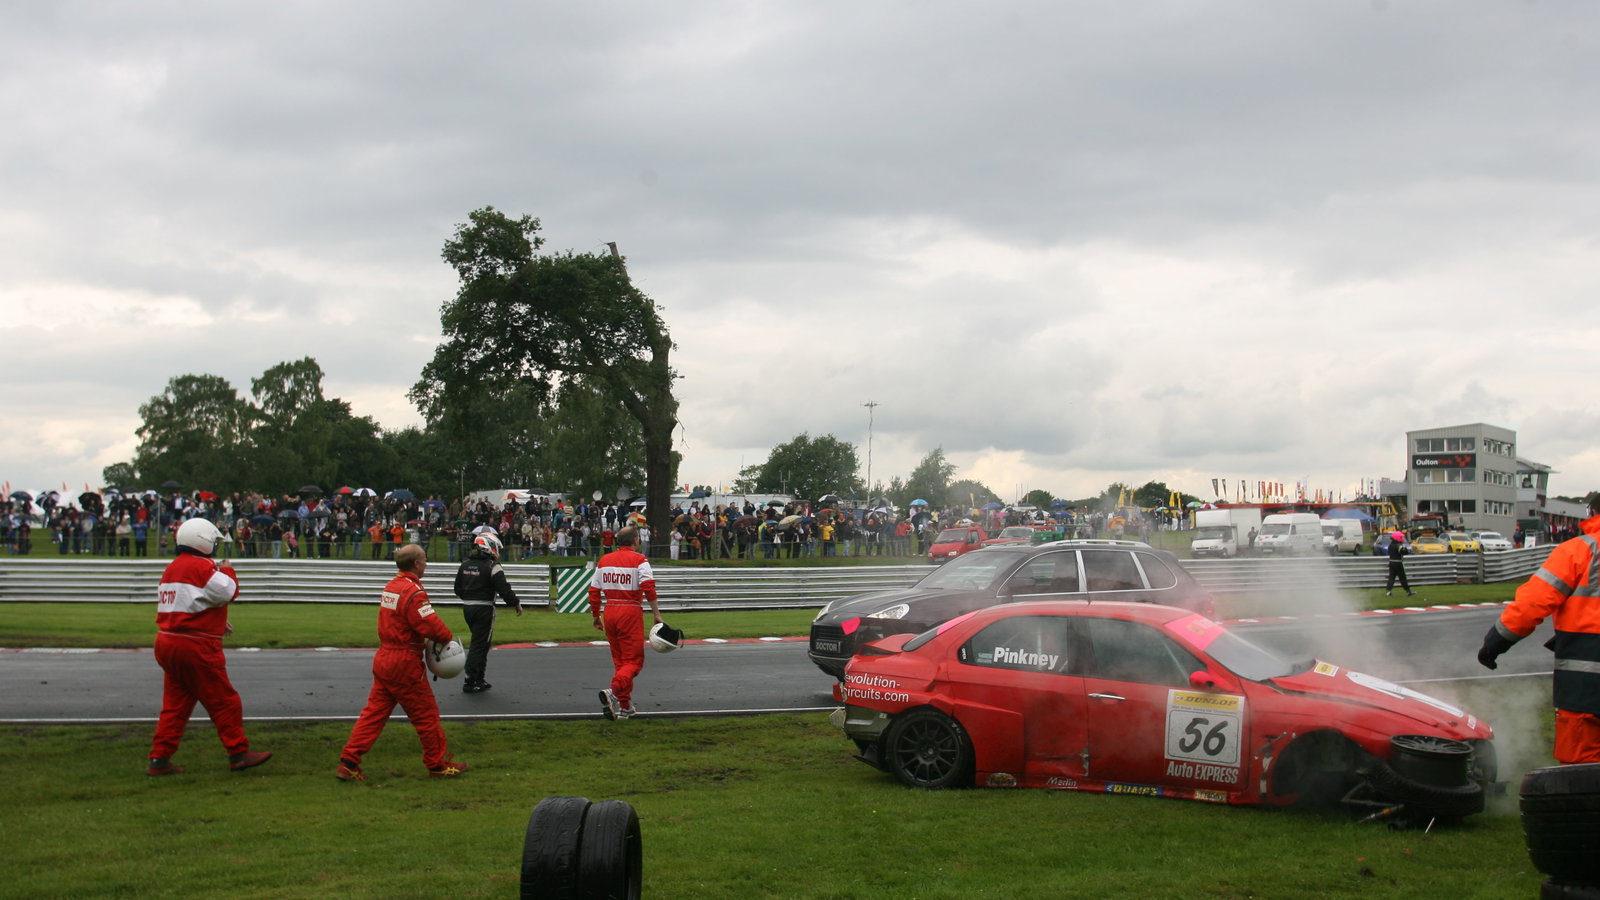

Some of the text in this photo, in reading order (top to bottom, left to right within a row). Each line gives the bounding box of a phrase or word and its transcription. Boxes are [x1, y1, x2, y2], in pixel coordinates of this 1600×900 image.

[602, 572, 632, 585] DOCTOR
[815, 641, 838, 652] DOCTOR
[993, 647, 1059, 670] Pinkney
[1184, 696, 1238, 706] DUNLOP
[1179, 717, 1229, 756] 56
[1166, 761, 1239, 784] Auto EXPRESS
